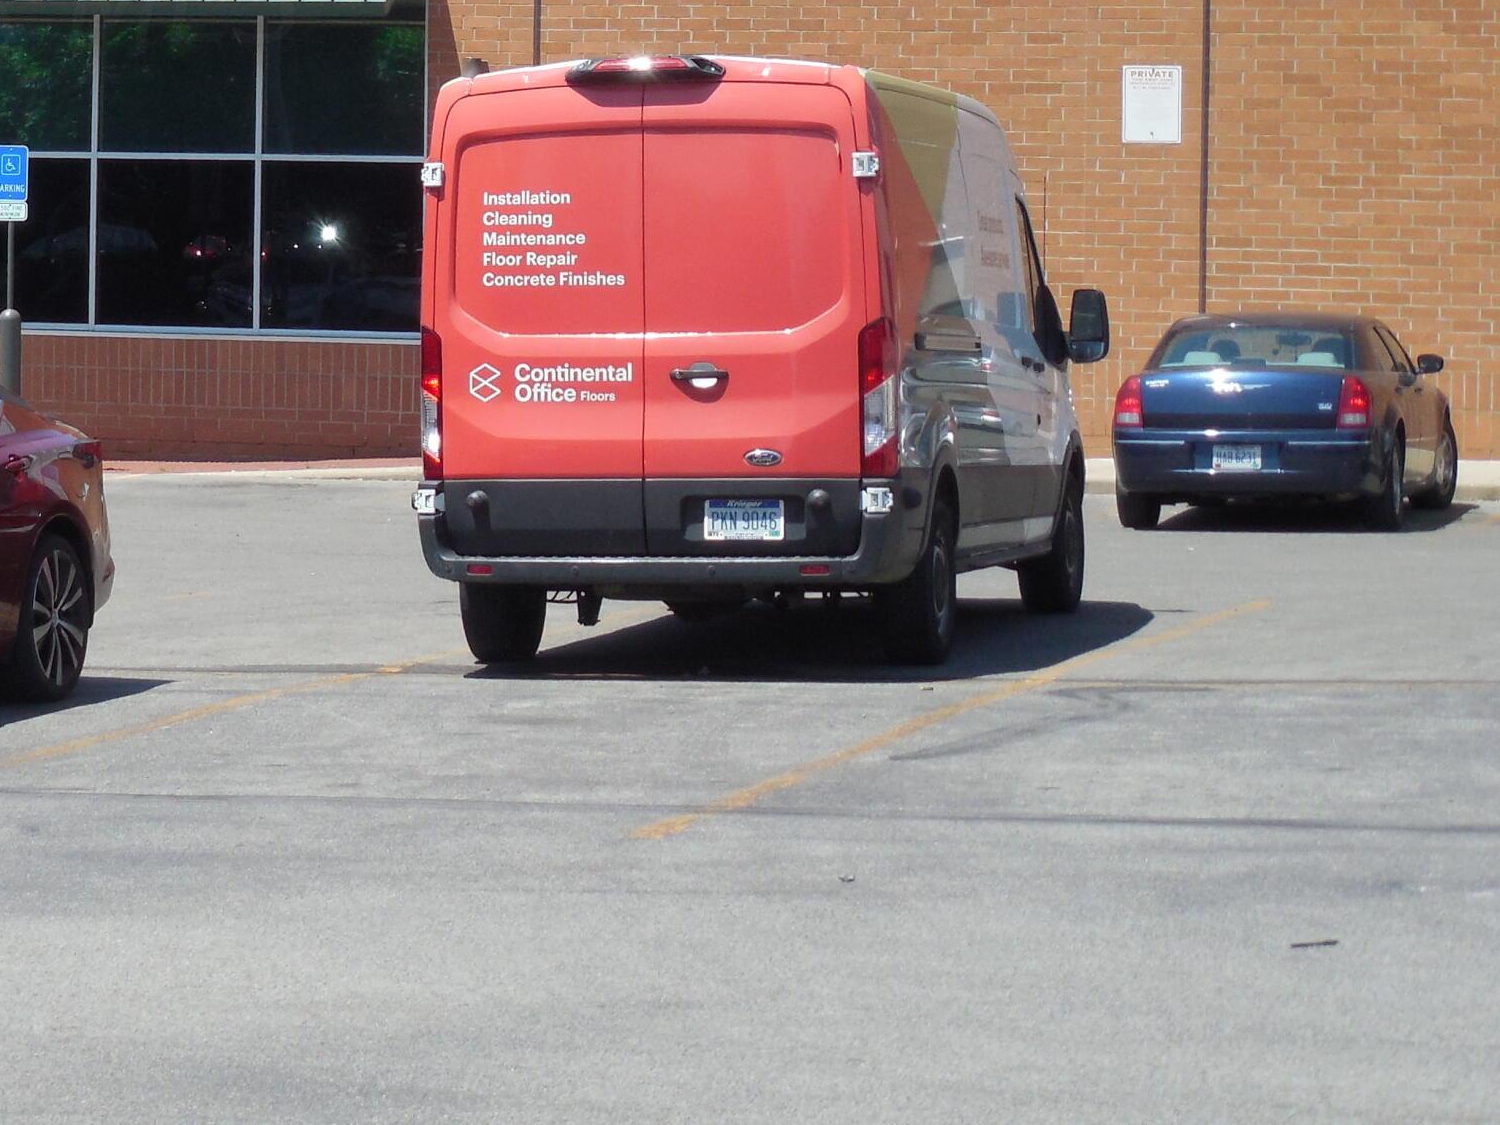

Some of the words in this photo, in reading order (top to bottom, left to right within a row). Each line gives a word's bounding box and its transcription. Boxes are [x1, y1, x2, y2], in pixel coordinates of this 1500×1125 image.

[1130, 70, 1173, 78] PRIVATE
[483, 191, 571, 205] Installation
[483, 211, 553, 228] Cleaning
[483, 232, 586, 246] Maintenance
[483, 252, 522, 266] Floor
[526, 251, 578, 268] Repair
[483, 272, 555, 286] Concrete
[559, 271, 625, 286] Finishes
[514, 362, 633, 382] Continental
[514, 383, 576, 402] Office
[580, 390, 615, 401] Floors
[711, 511, 738, 530] PKN
[742, 511, 777, 530] 9046
